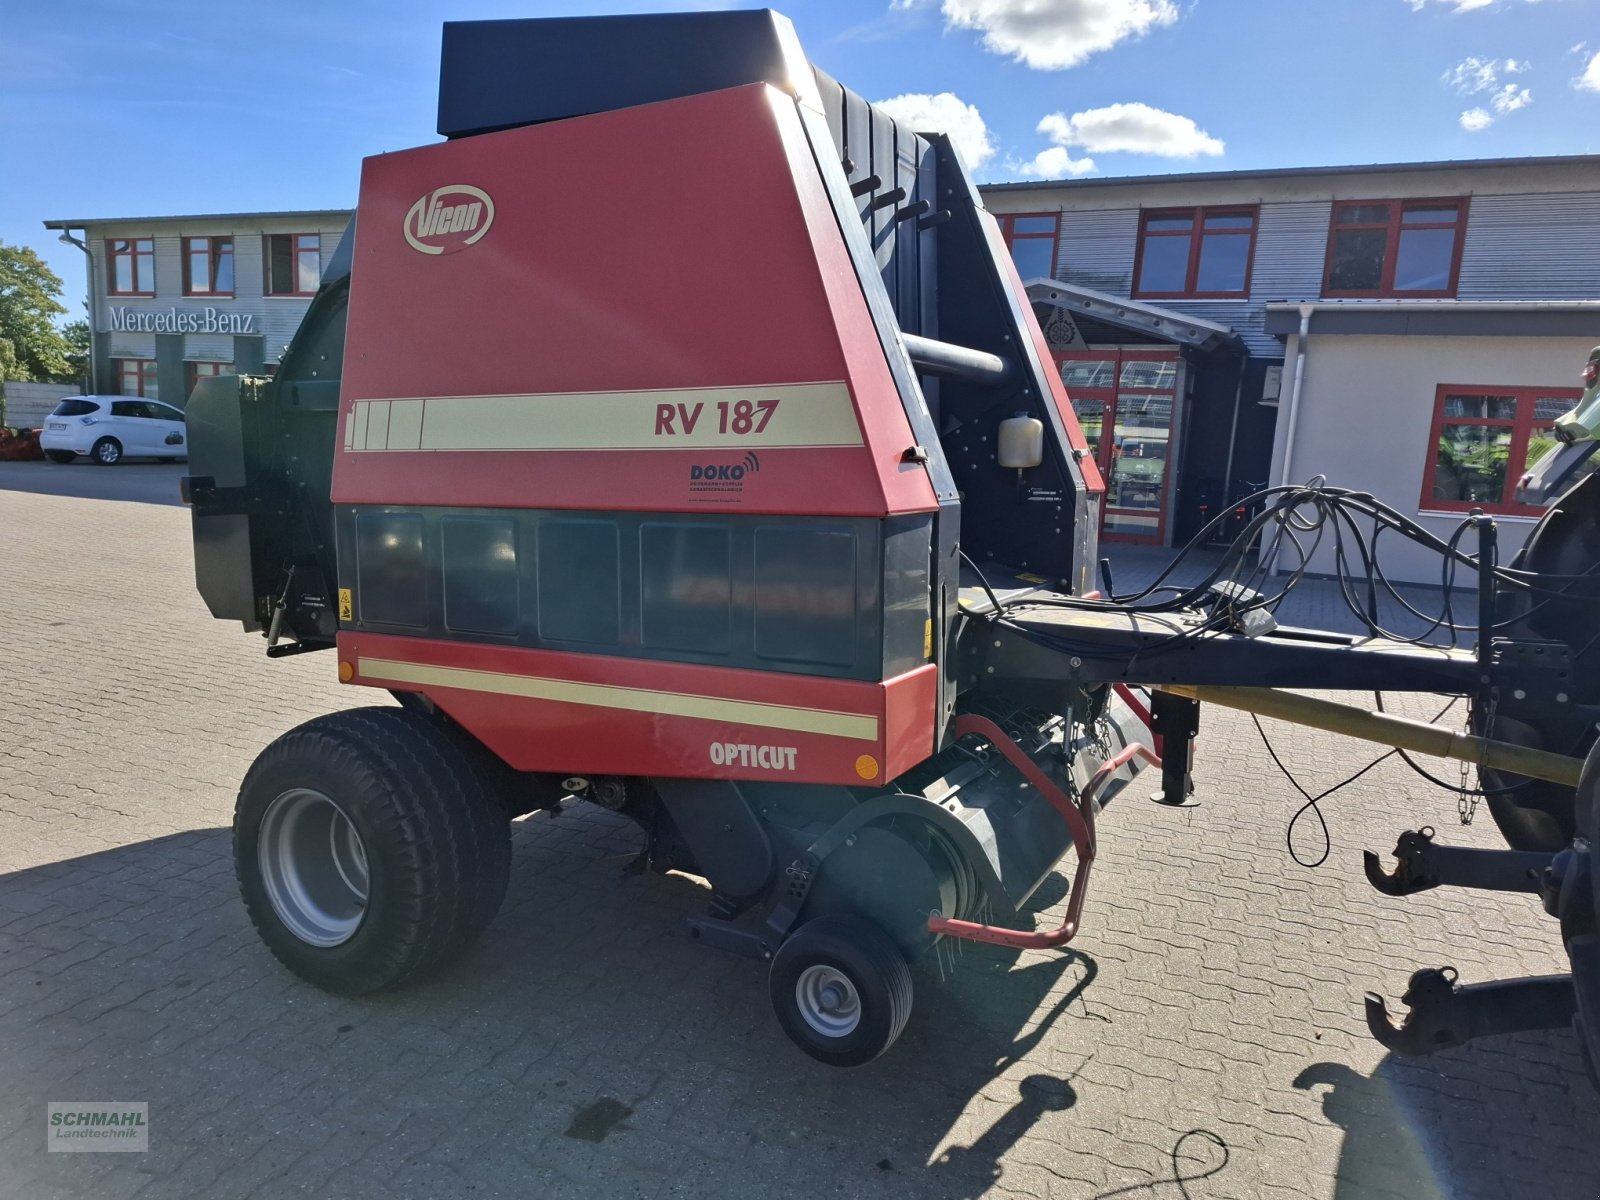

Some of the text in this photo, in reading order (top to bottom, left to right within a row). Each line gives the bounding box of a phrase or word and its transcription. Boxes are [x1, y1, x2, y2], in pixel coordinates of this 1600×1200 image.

[414, 193, 484, 239] Vicon
[109, 306, 253, 334] Mercedes-Benz
[654, 399, 781, 436] RV 187
[690, 464, 745, 480] DOKO
[709, 742, 798, 771] OPTICUT
